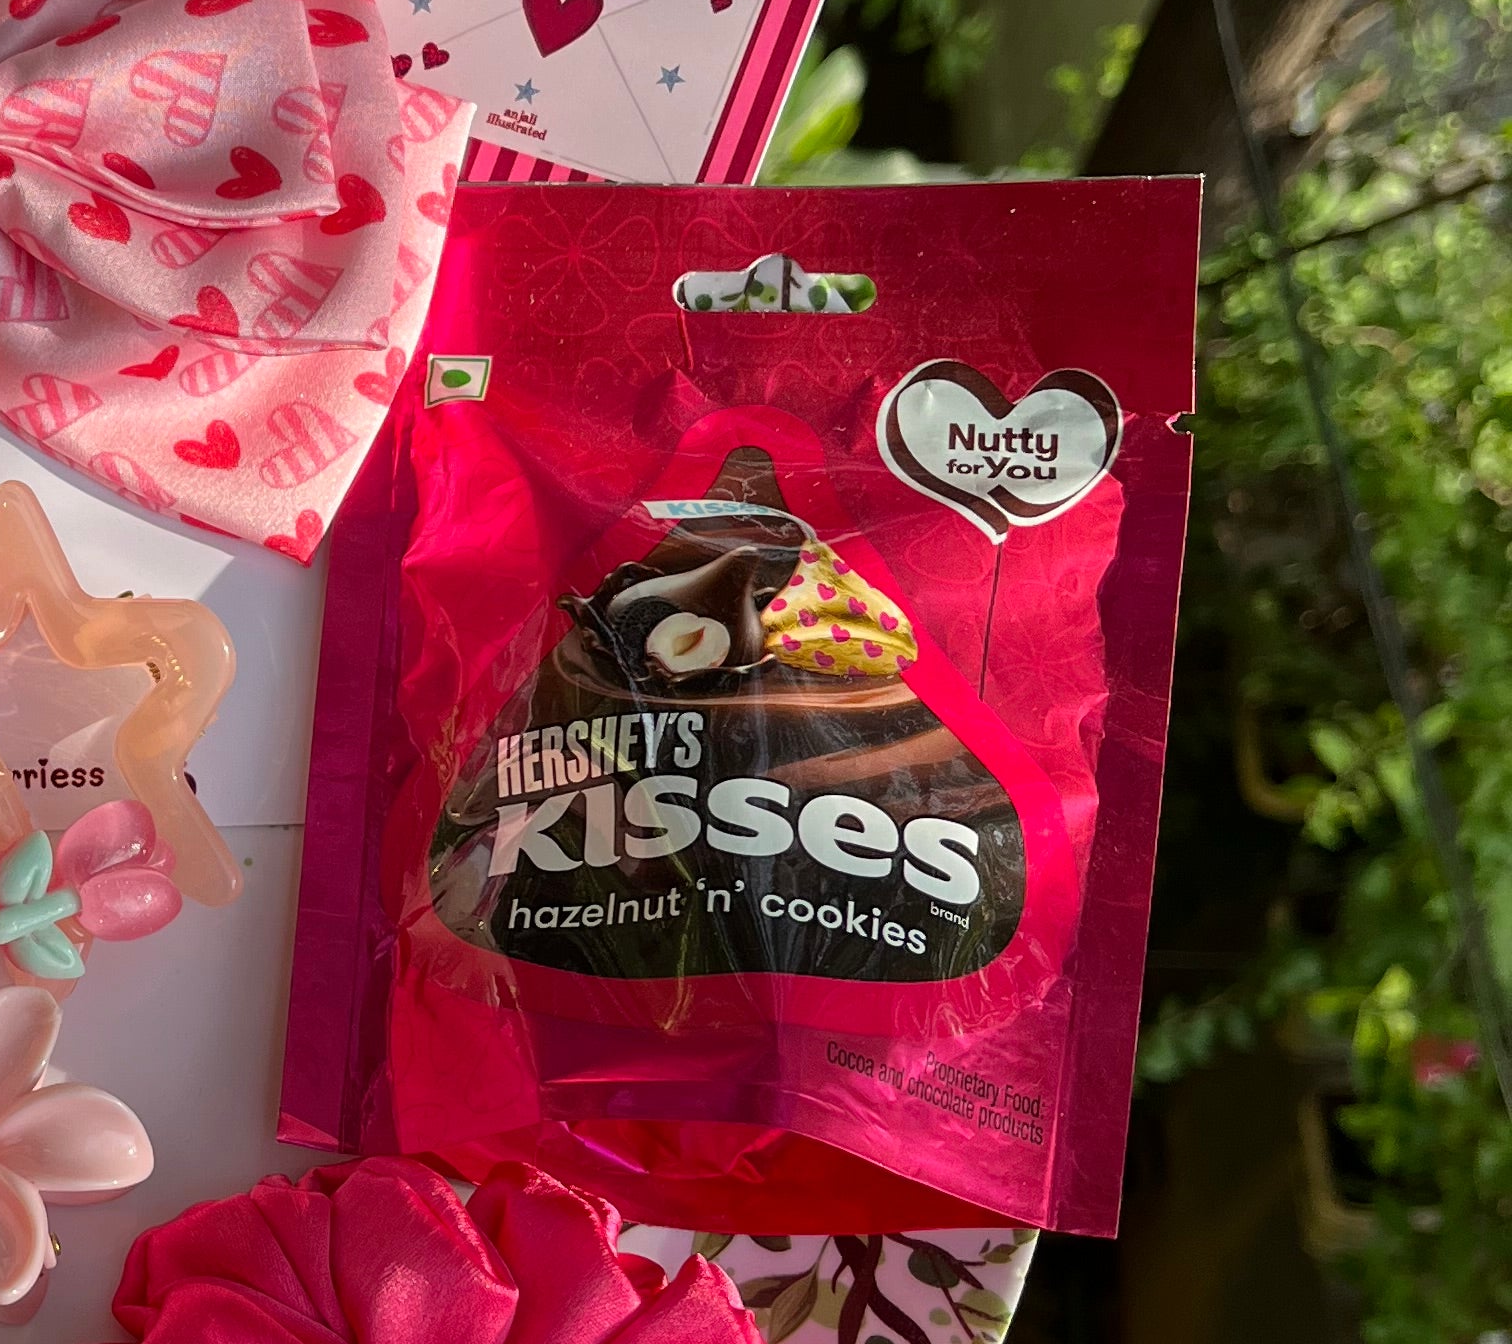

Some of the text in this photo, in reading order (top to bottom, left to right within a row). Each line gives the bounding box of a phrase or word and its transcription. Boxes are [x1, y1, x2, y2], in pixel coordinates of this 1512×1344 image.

[486, 112, 548, 141] illustrated
[504, 107, 539, 126] anjali
[948, 422, 1059, 462] Nutty
[946, 456, 1057, 480] for You
[496, 711, 704, 799] HERSHEY'S
[507, 887, 681, 930] hazelnut
[760, 893, 927, 956] cookies
[930, 901, 970, 930] brand
[826, 1040, 1044, 1145] Cocoa and chocolate products
[924, 1050, 1046, 1119] Proprietary Food:
